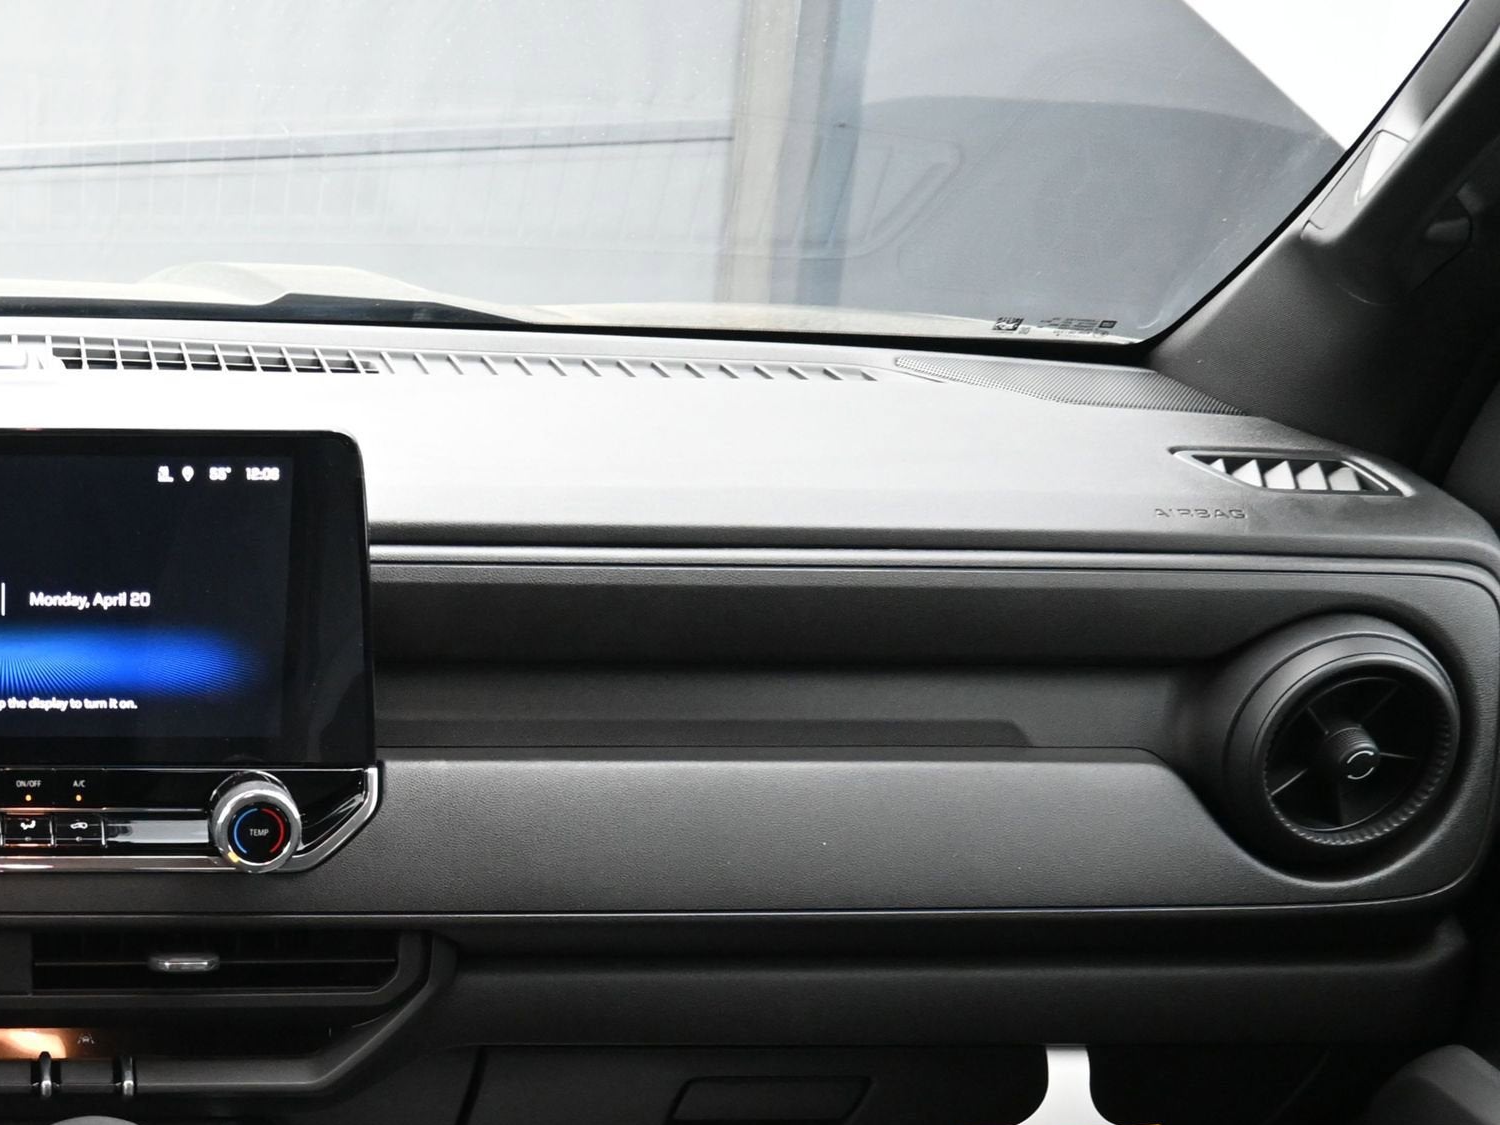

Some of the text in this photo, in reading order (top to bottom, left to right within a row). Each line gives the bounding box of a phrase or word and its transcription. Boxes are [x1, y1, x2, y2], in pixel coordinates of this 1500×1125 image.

[29, 592, 150, 610] Monday, April 20
[8, 697, 27, 709] the
[28, 697, 68, 711] display
[69, 698, 82, 709] to
[84, 698, 107, 709] turn
[119, 699, 138, 709] on.
[16, 780, 41, 788] ON/OFF
[73, 780, 86, 788] A/C
[249, 829, 269, 837] TEMP
